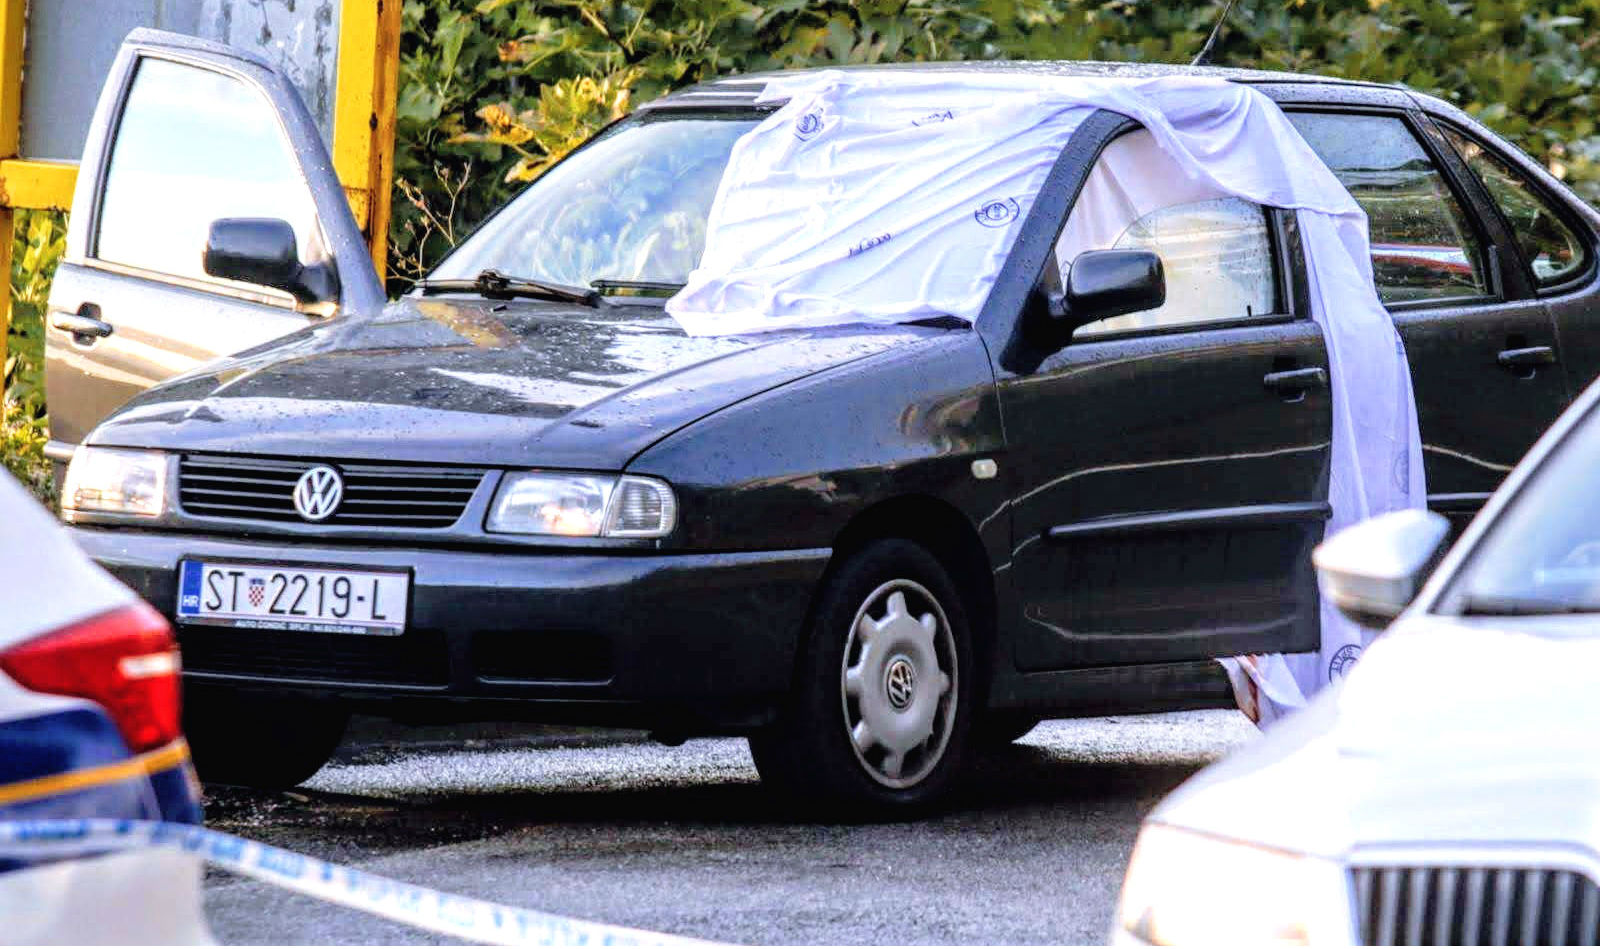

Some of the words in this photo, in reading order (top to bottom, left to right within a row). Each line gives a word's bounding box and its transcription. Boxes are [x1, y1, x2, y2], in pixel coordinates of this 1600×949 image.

[295, 468, 341, 518] VW
[182, 594, 200, 607] HR
[205, 569, 245, 612] ST
[268, 572, 386, 620] 2219-L
